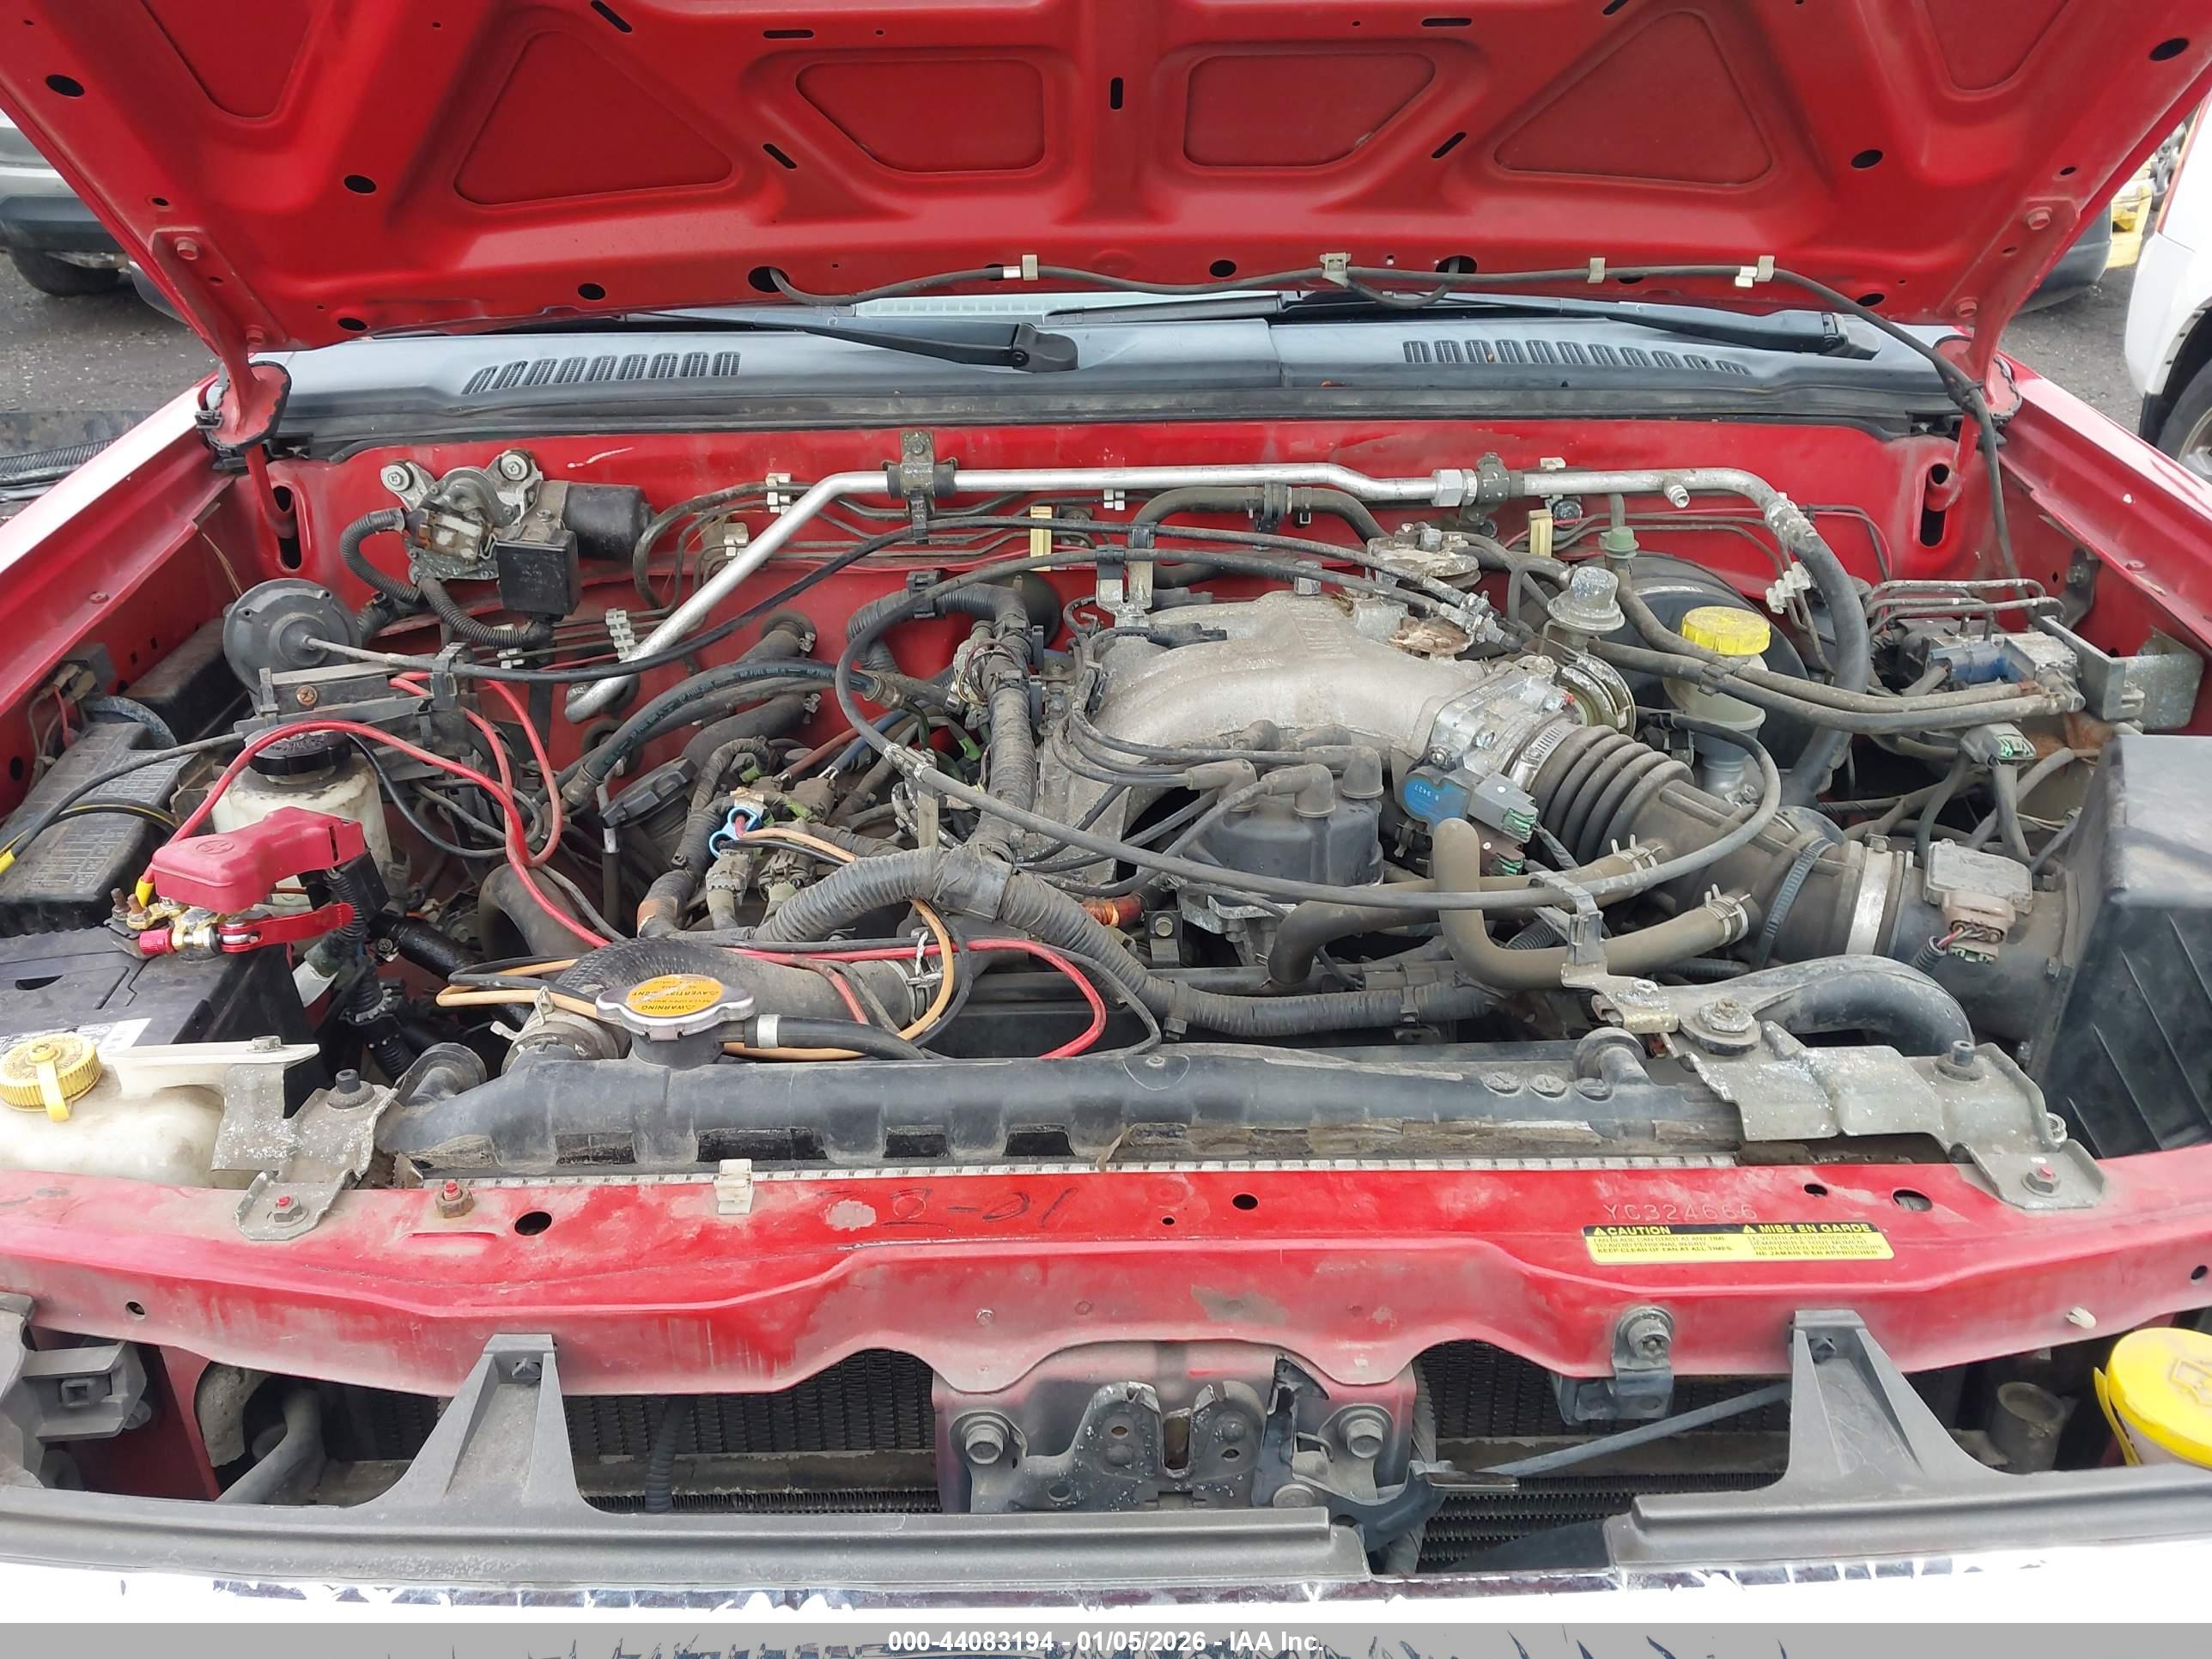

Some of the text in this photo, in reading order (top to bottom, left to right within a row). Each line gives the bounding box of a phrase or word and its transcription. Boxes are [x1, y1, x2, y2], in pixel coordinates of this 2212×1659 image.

[1607, 1225, 1672, 1236] CAUTION
[1759, 1224, 1872, 1233] MISE EN GARDE
